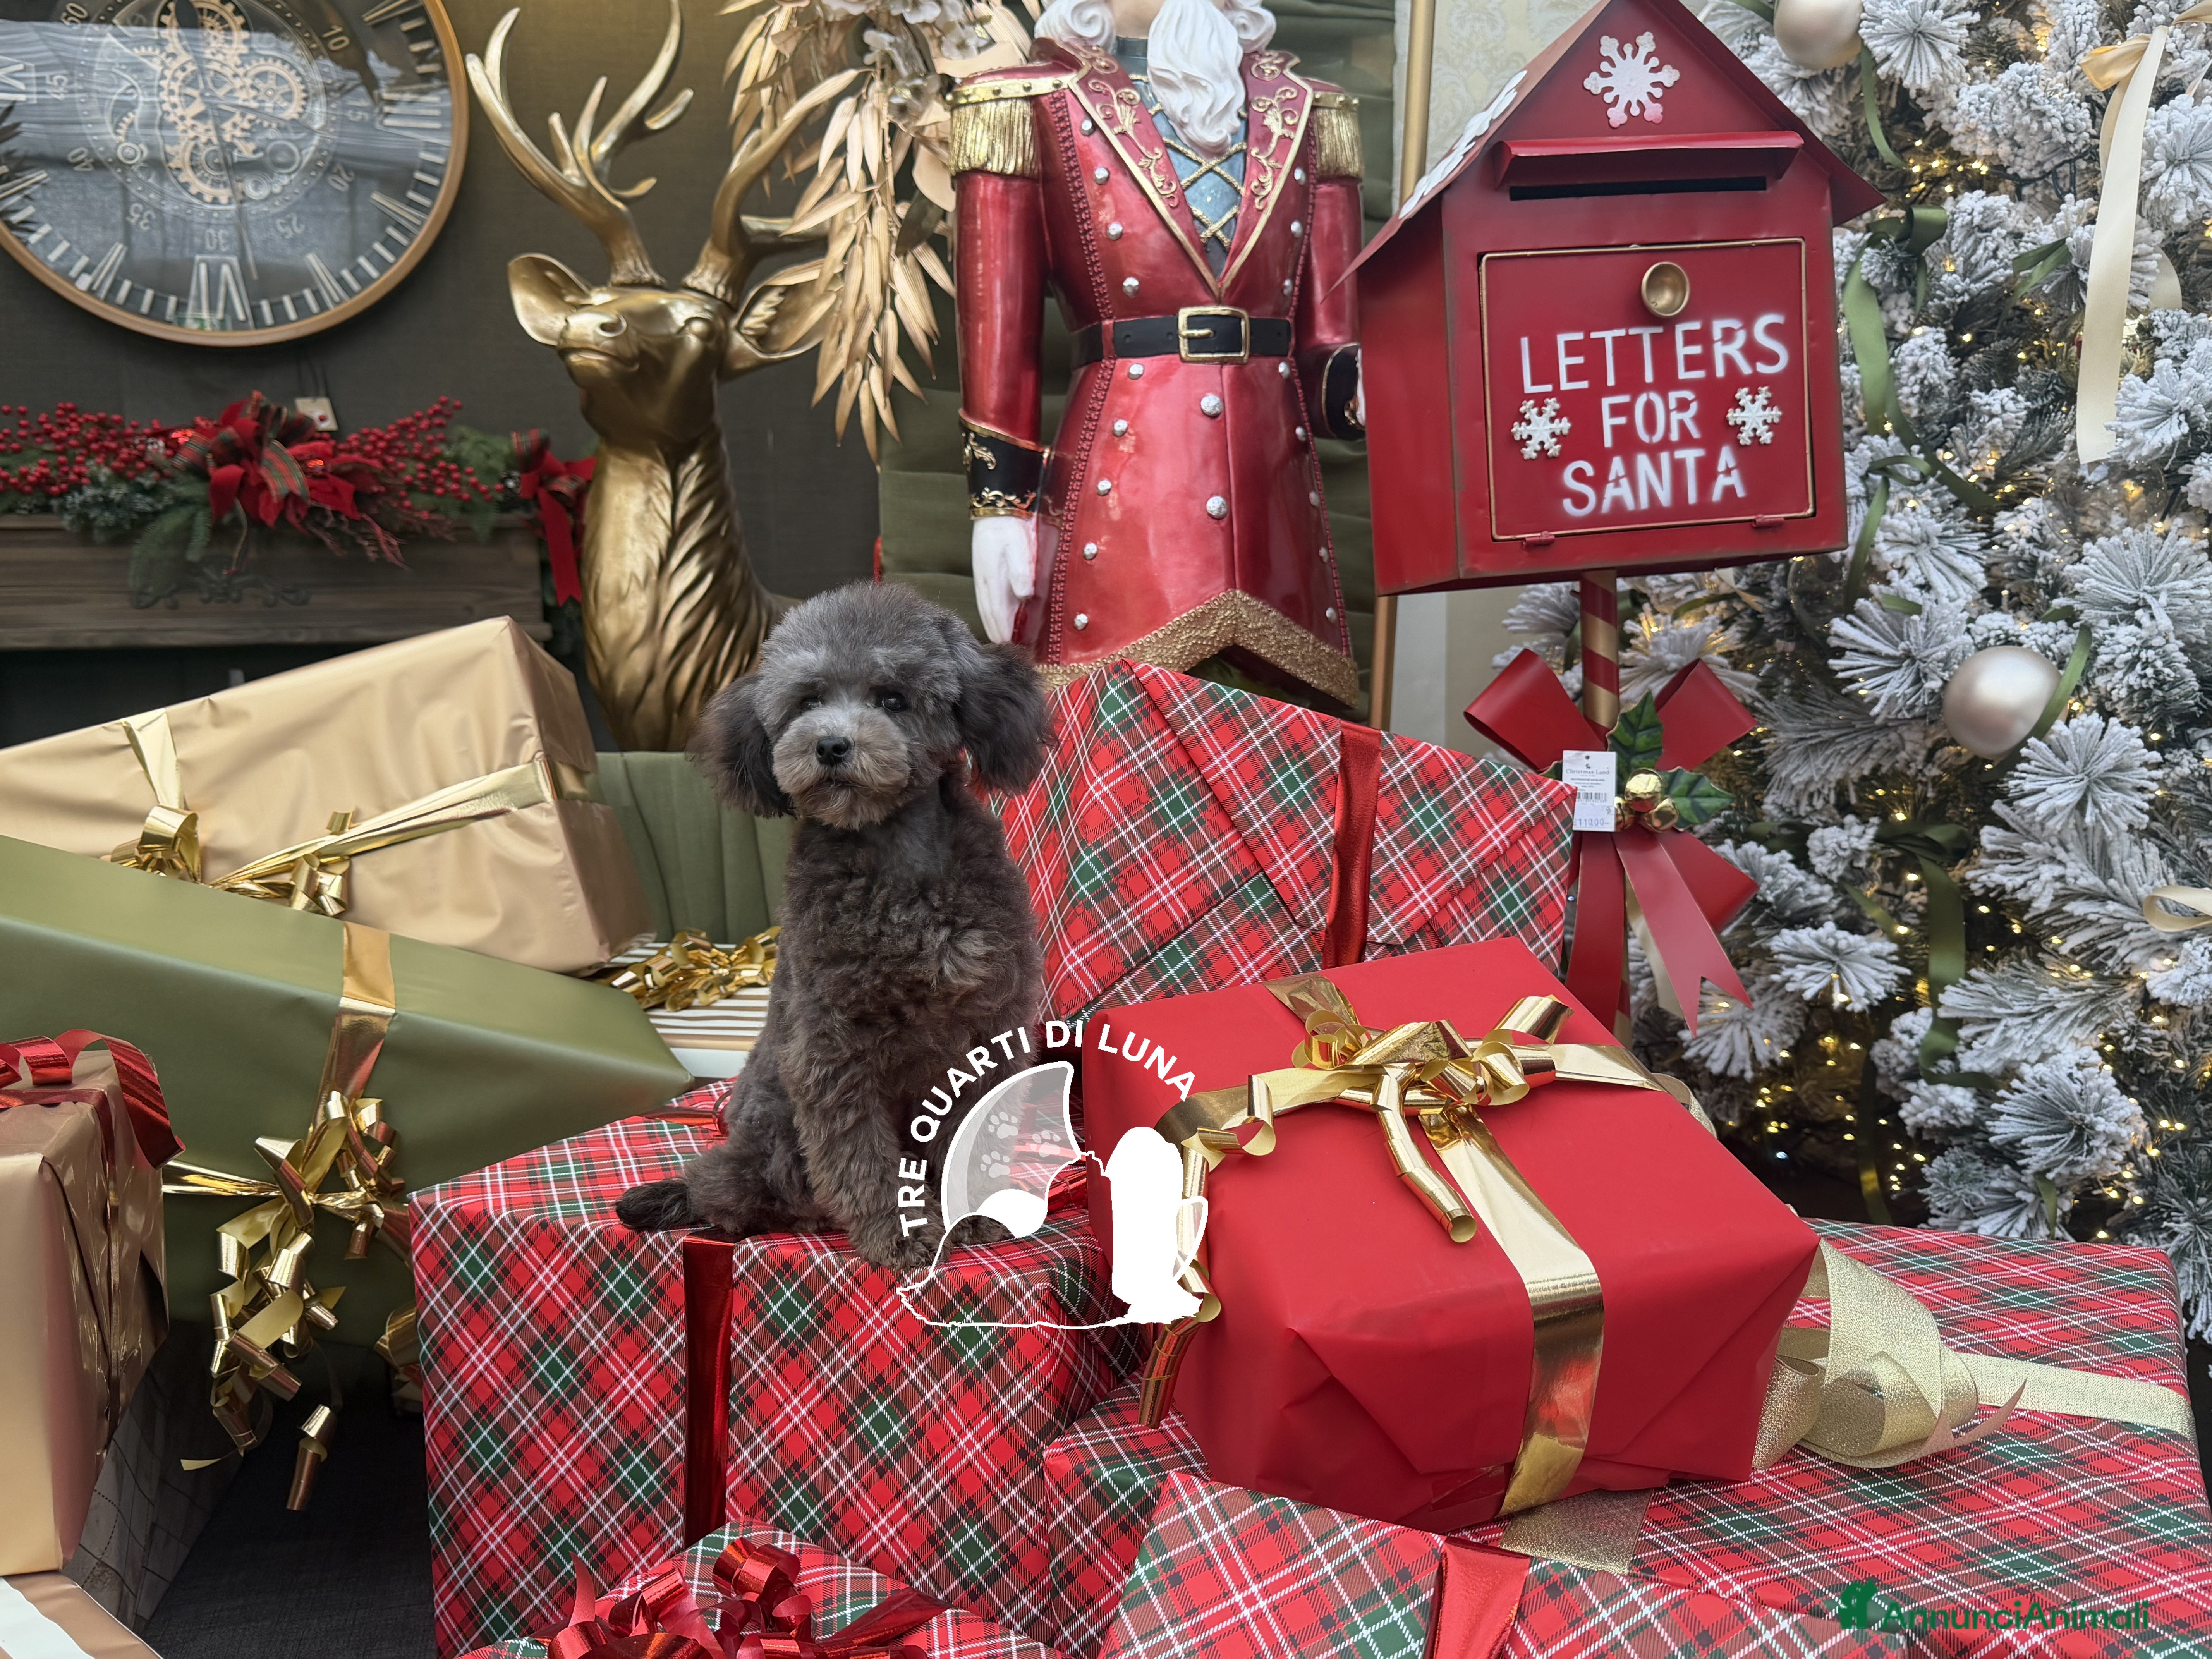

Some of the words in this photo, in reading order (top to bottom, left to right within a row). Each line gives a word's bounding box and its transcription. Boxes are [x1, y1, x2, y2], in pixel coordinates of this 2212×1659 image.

[61, 3, 89, 27] 50
[322, 25, 350, 51] 10
[45, 74, 69, 101] 45
[345, 100, 373, 122] 15
[67, 146, 95, 172] 40
[327, 163, 356, 192] 20
[126, 202, 156, 231] 35
[276, 213, 306, 239] 25
[204, 228, 231, 252] 30
[1519, 313, 1789, 394] LETTERS
[1601, 390, 1700, 448] FOR
[1562, 445, 1747, 518] SANTA
